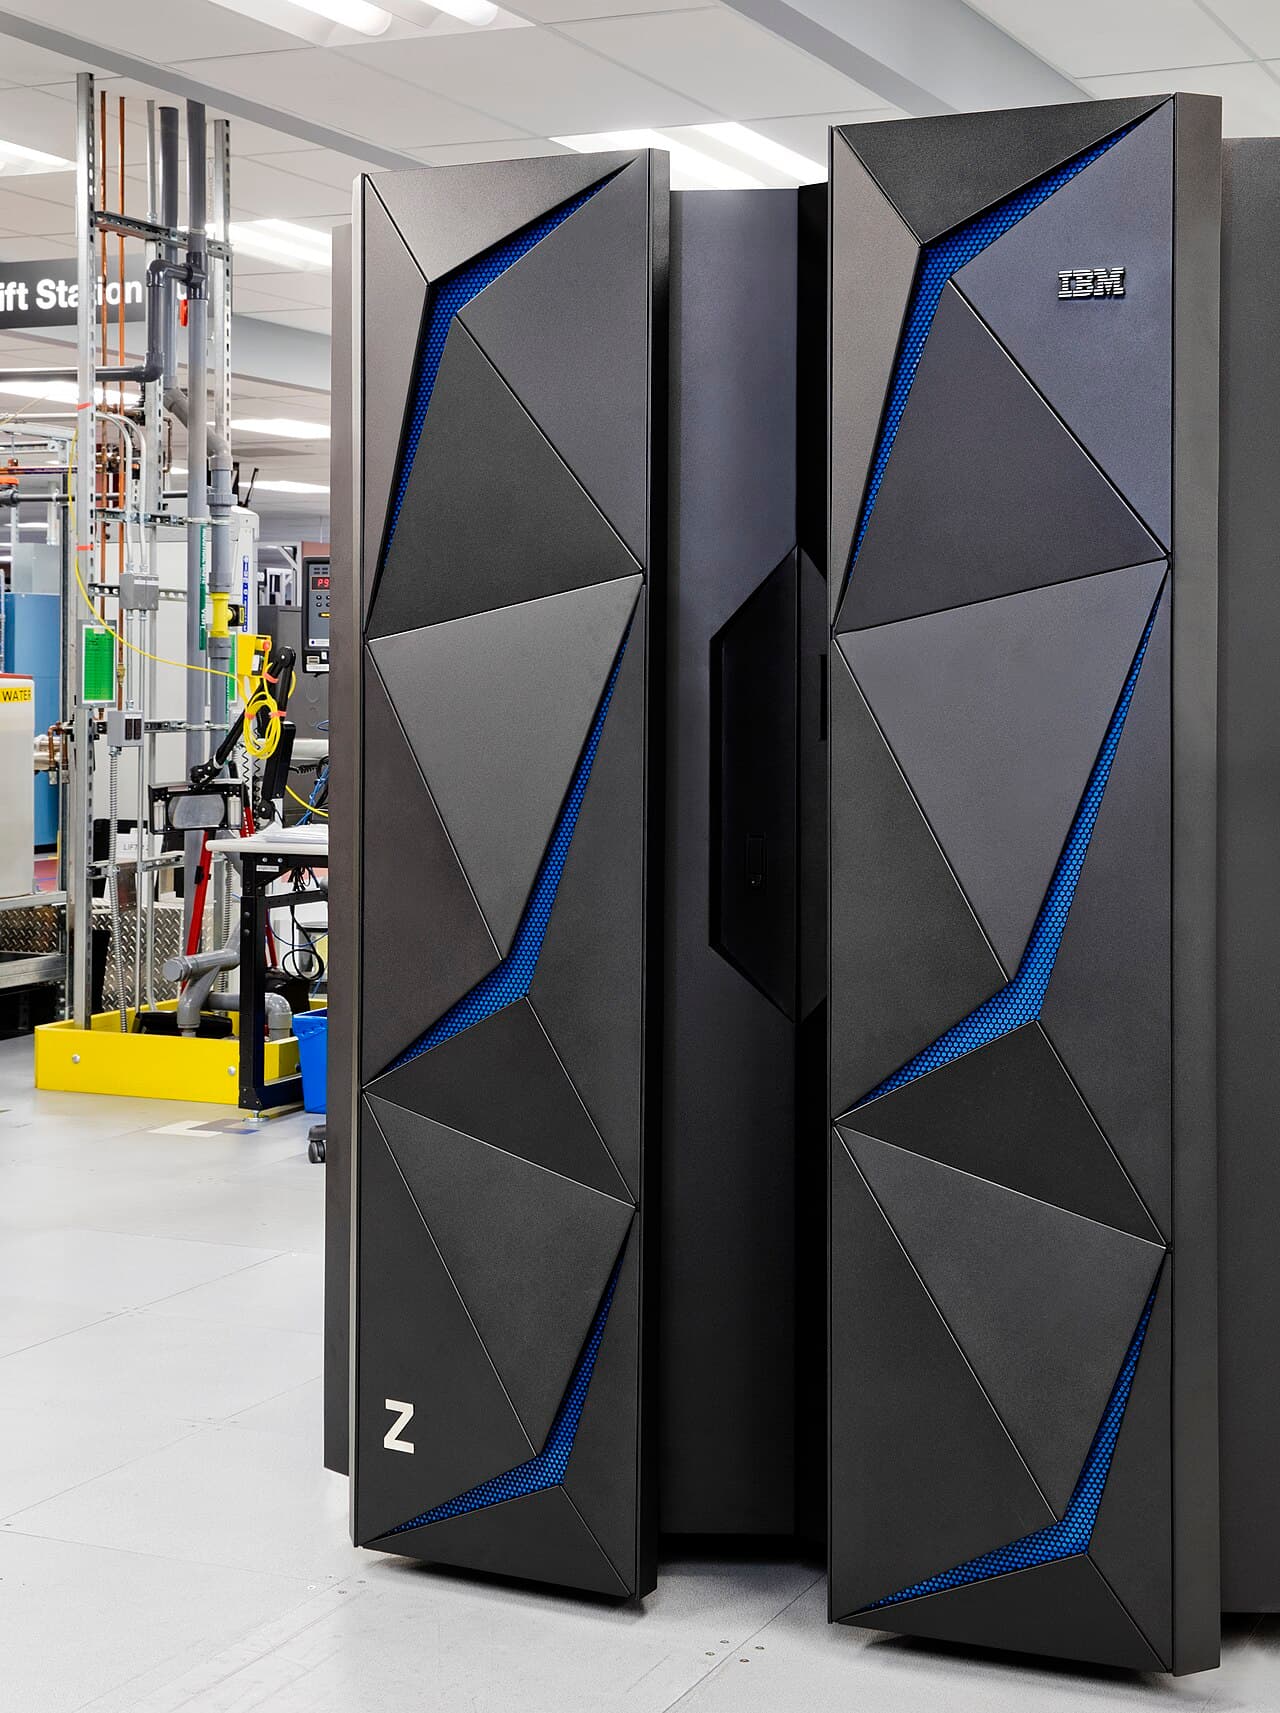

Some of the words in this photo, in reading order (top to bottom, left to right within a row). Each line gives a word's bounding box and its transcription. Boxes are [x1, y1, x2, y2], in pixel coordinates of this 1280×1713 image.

[36, 276, 142, 310] Staion
[1058, 266, 1125, 299] IBM
[2, 689, 31, 701] WATER
